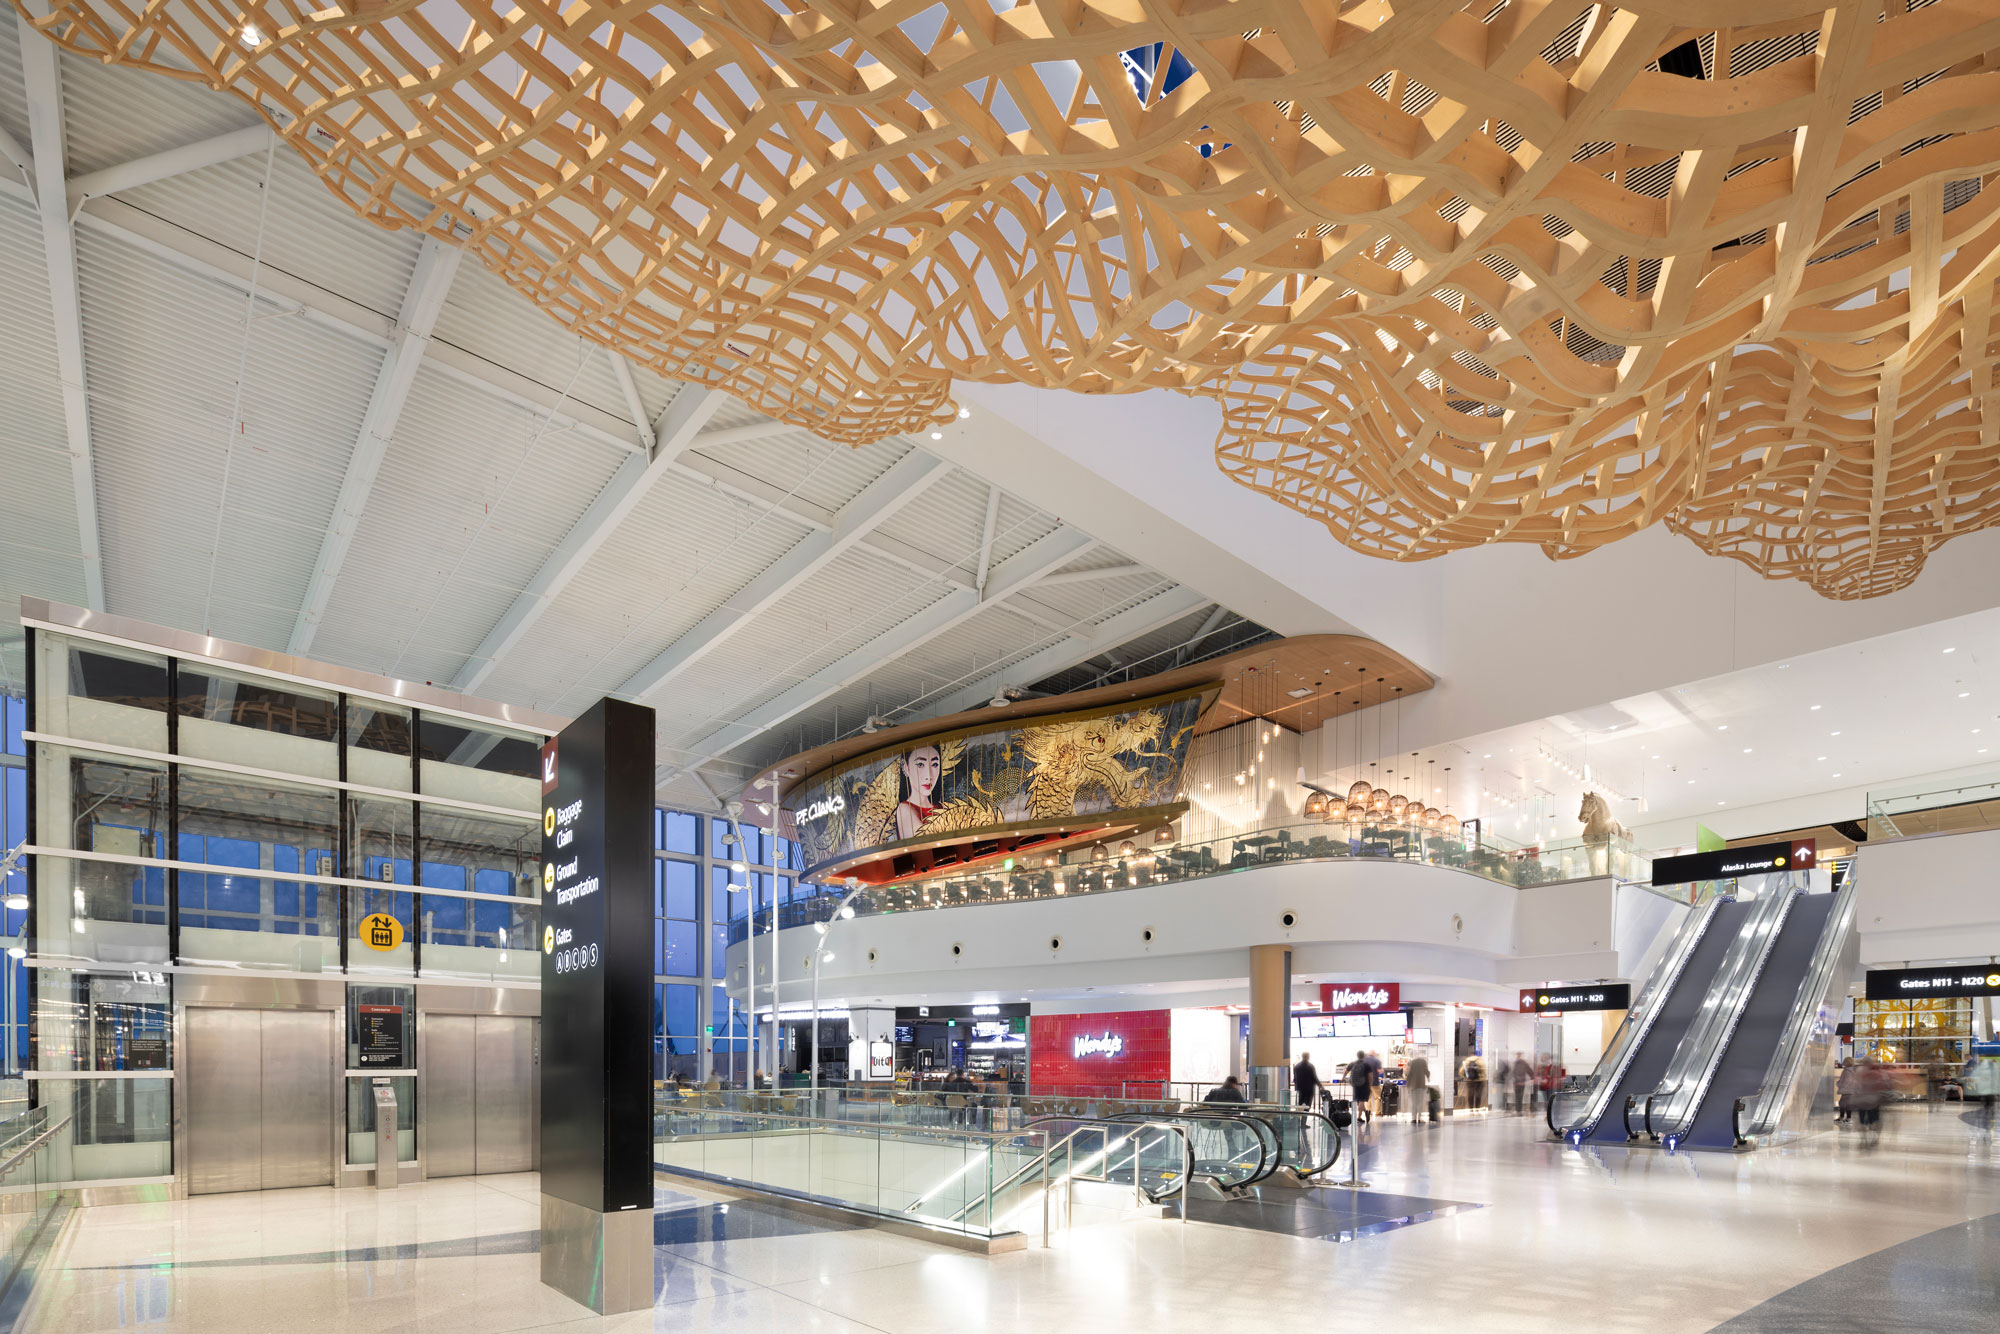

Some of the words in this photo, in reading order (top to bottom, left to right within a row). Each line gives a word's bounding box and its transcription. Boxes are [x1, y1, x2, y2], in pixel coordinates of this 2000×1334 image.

[556, 799, 582, 826] Baggage
[556, 828, 573, 849] Claim
[556, 855, 578, 881] Ground
[1721, 863, 1745, 872] Alaska
[1746, 860, 1773, 869] Lounge
[556, 876, 599, 906] Transportation
[556, 928, 572, 946] Gates
[1900, 979, 1930, 988] Gates
[1932, 978, 1952, 987] N11
[1961, 977, 1985, 986] N20
[1332, 985, 1389, 1010] Wendy's
[1549, 996, 1569, 1004] Gates
[1570, 995, 1583, 1003] N11
[1589, 994, 1604, 1002] N20
[1074, 1031, 1123, 1058] Wendy's
